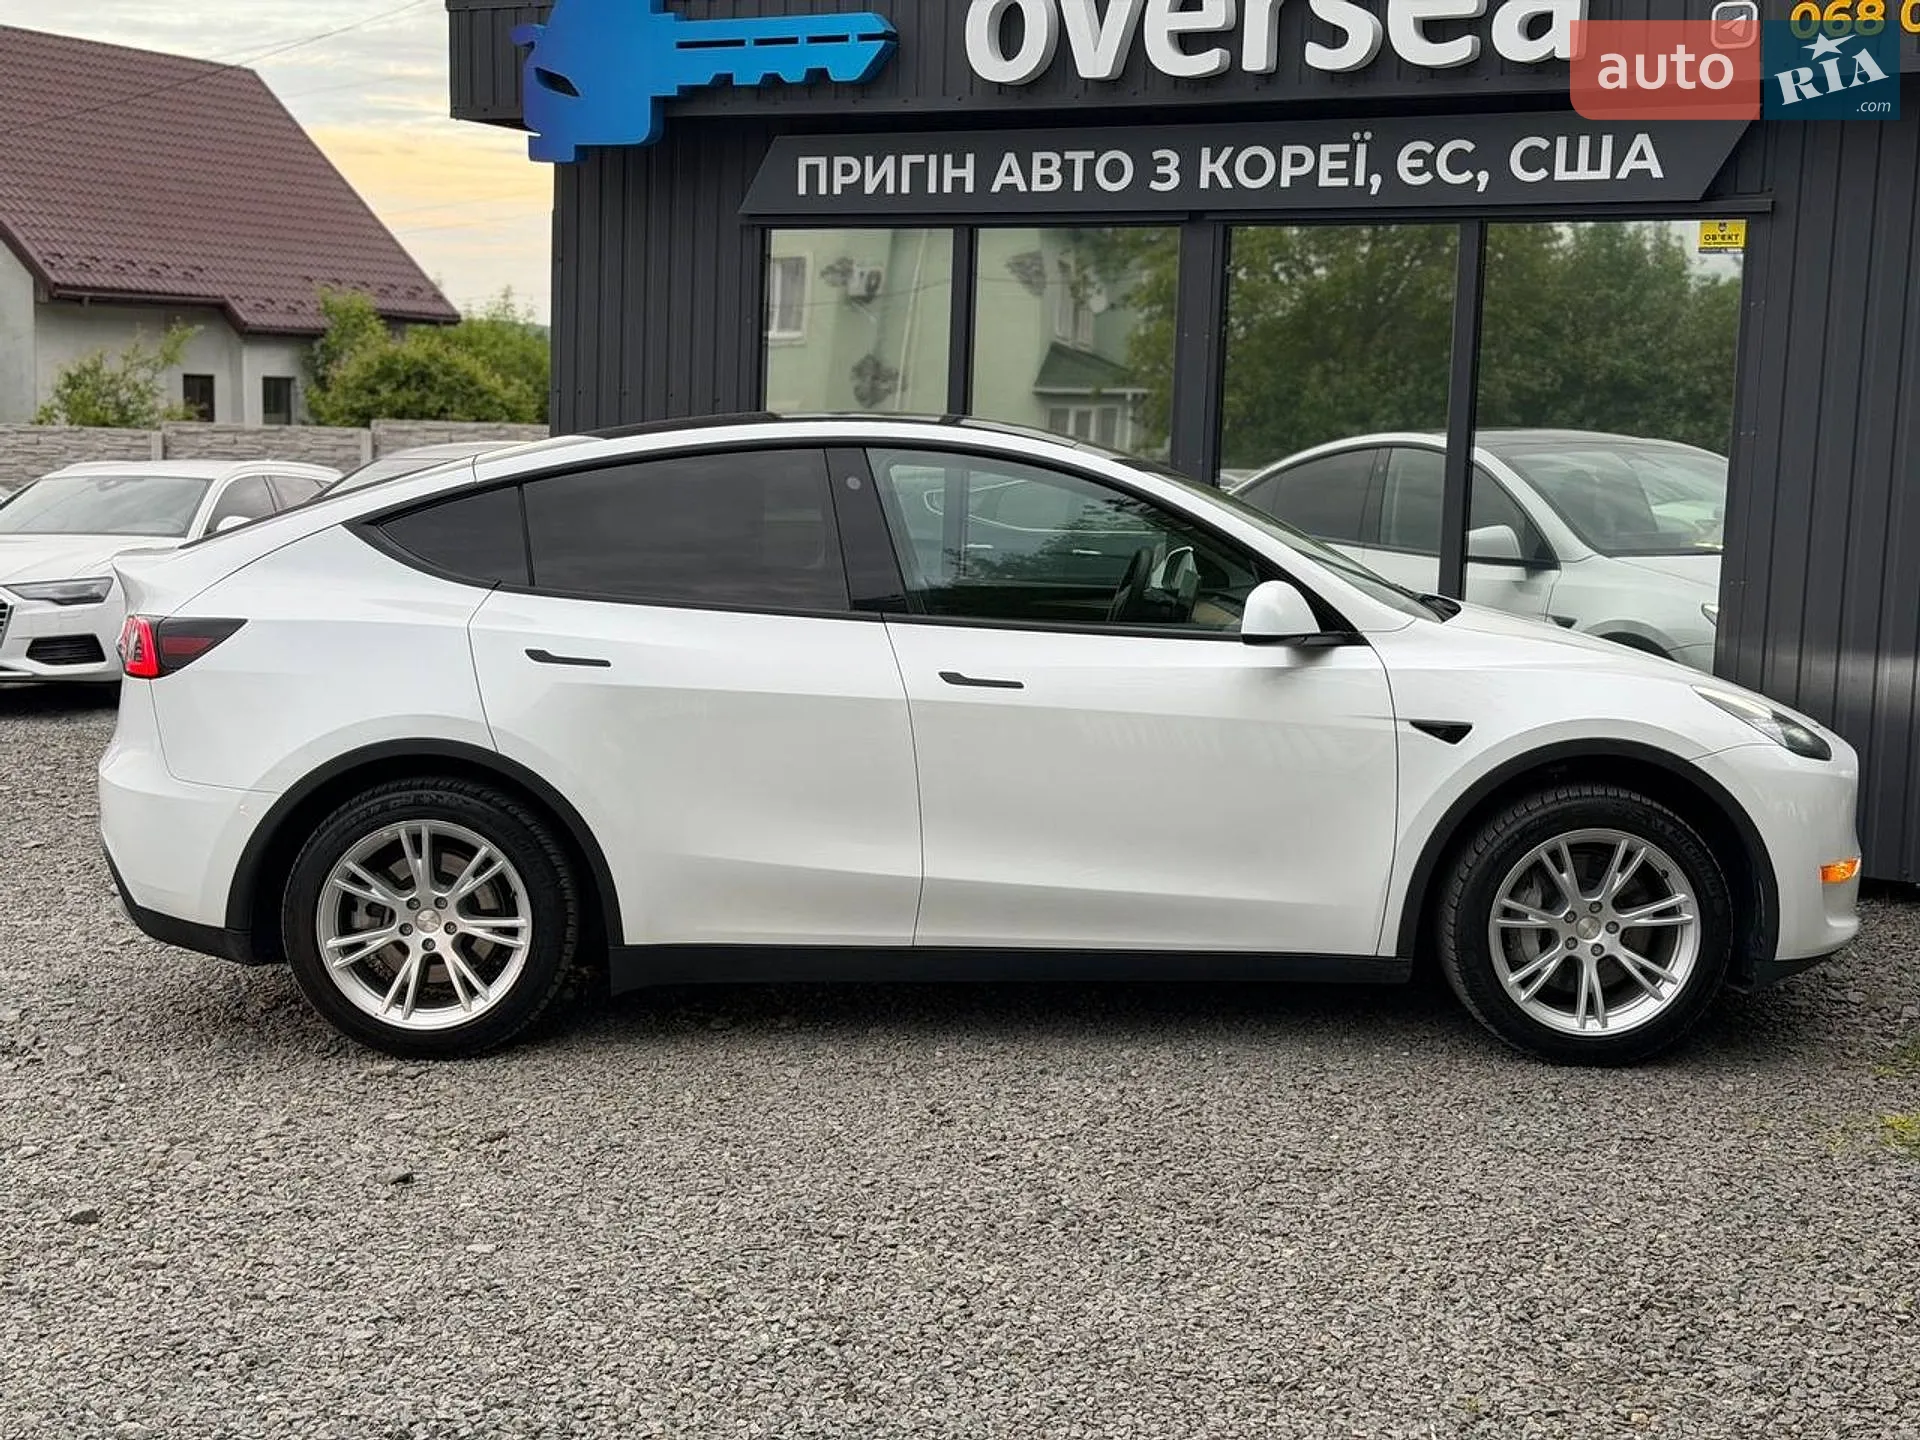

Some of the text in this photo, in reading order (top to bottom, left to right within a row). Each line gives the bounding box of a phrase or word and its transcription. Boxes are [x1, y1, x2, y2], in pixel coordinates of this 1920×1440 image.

[965, 0, 1589, 85] oversea
[1791, 0, 1885, 39] 068
[798, 153, 974, 196] ПРИГІН
[990, 149, 1134, 193] АВТО
[1199, 131, 1382, 195] КОРЕЇ,
[1396, 139, 1489, 193] ЄС,
[1509, 132, 1665, 183] США
